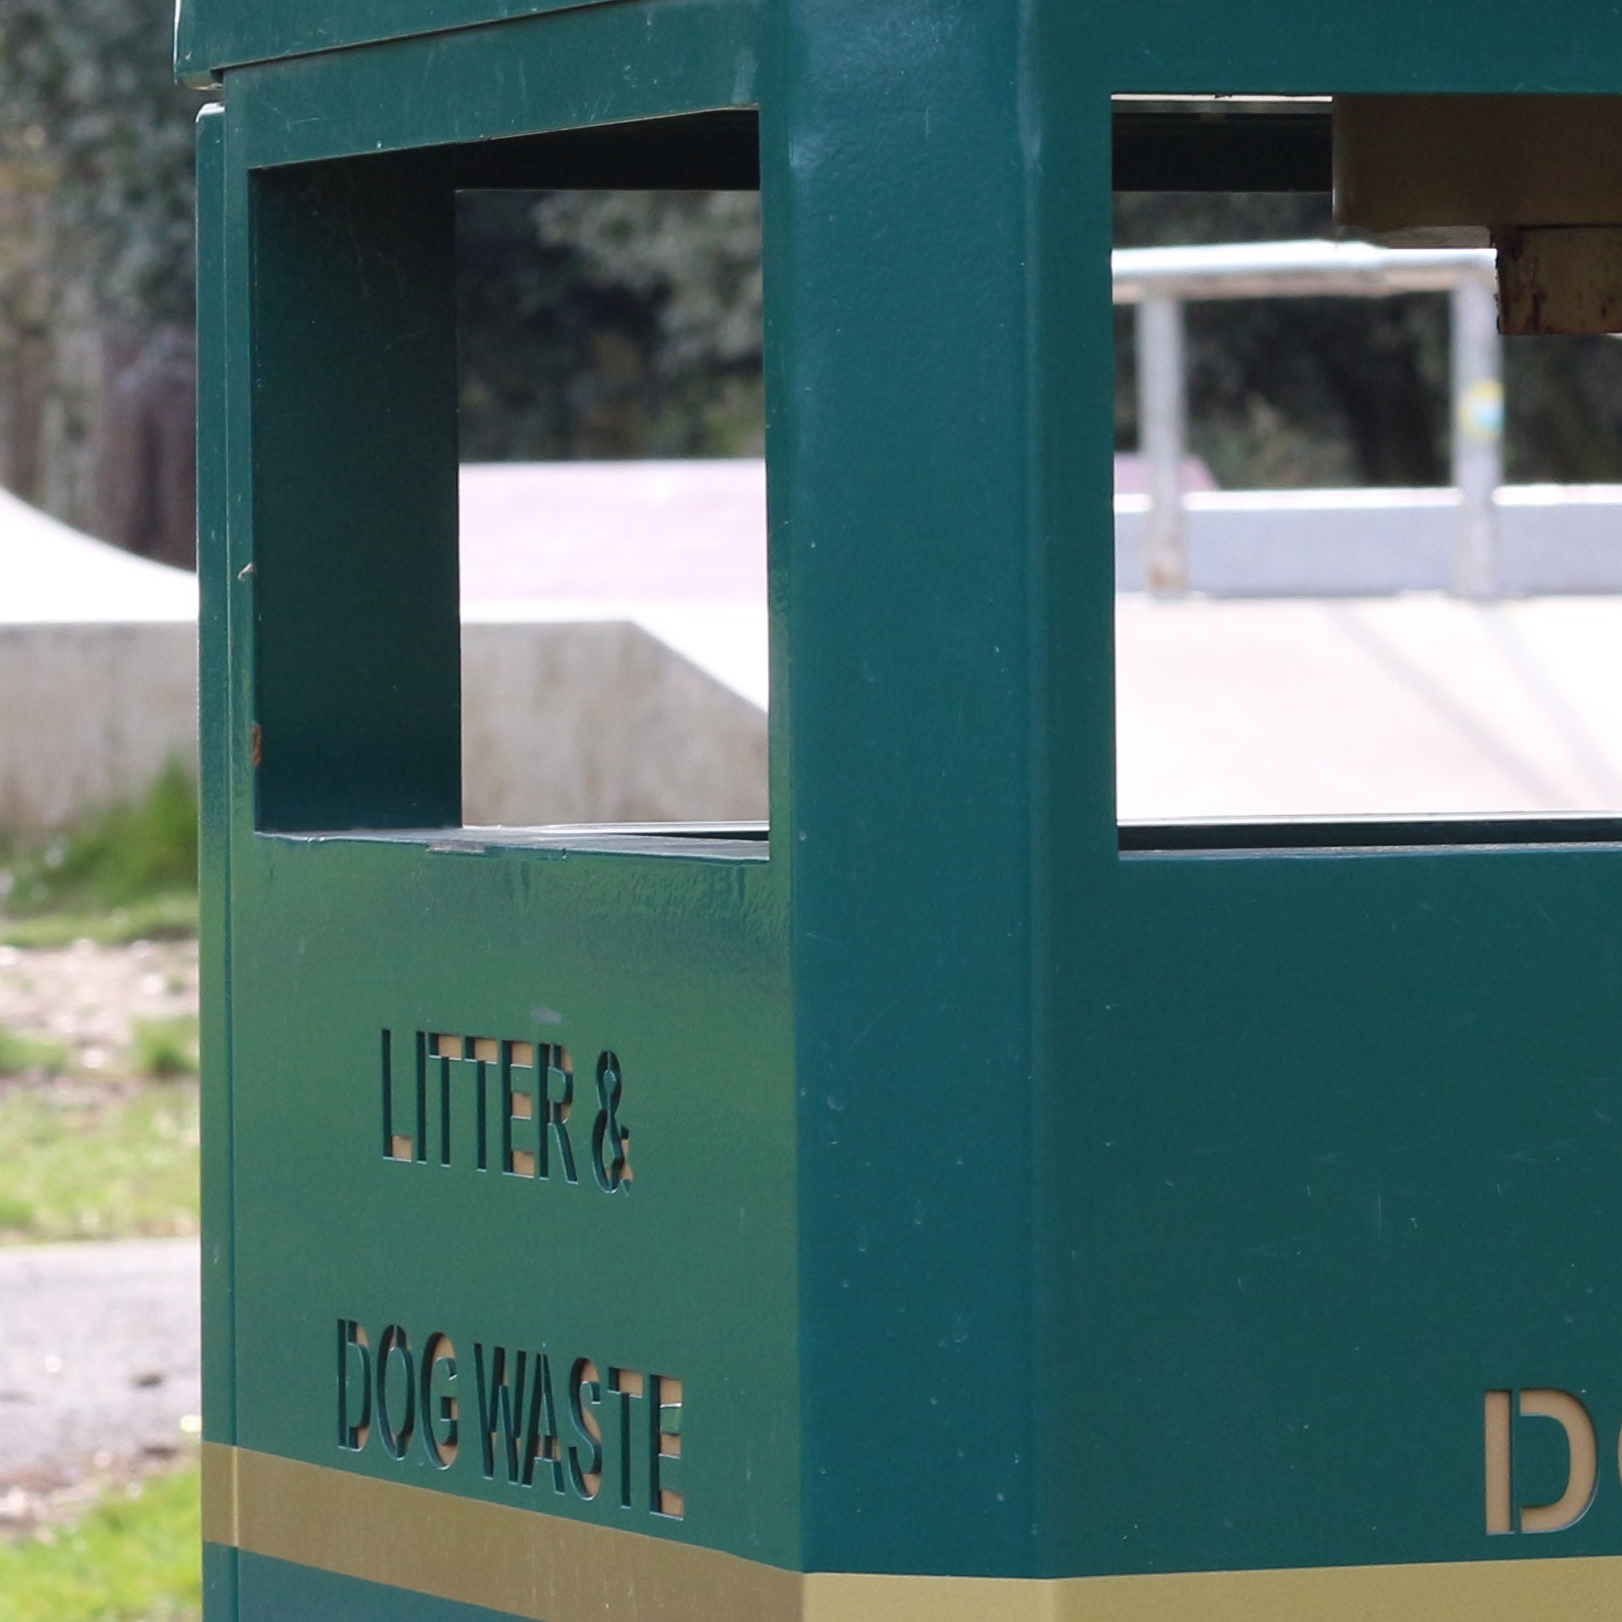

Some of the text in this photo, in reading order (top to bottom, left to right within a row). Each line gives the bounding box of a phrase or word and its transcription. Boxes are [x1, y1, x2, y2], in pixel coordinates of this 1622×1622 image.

[382, 1029, 633, 1196] LITTER &
[337, 1319, 684, 1521] DOG WASTE
